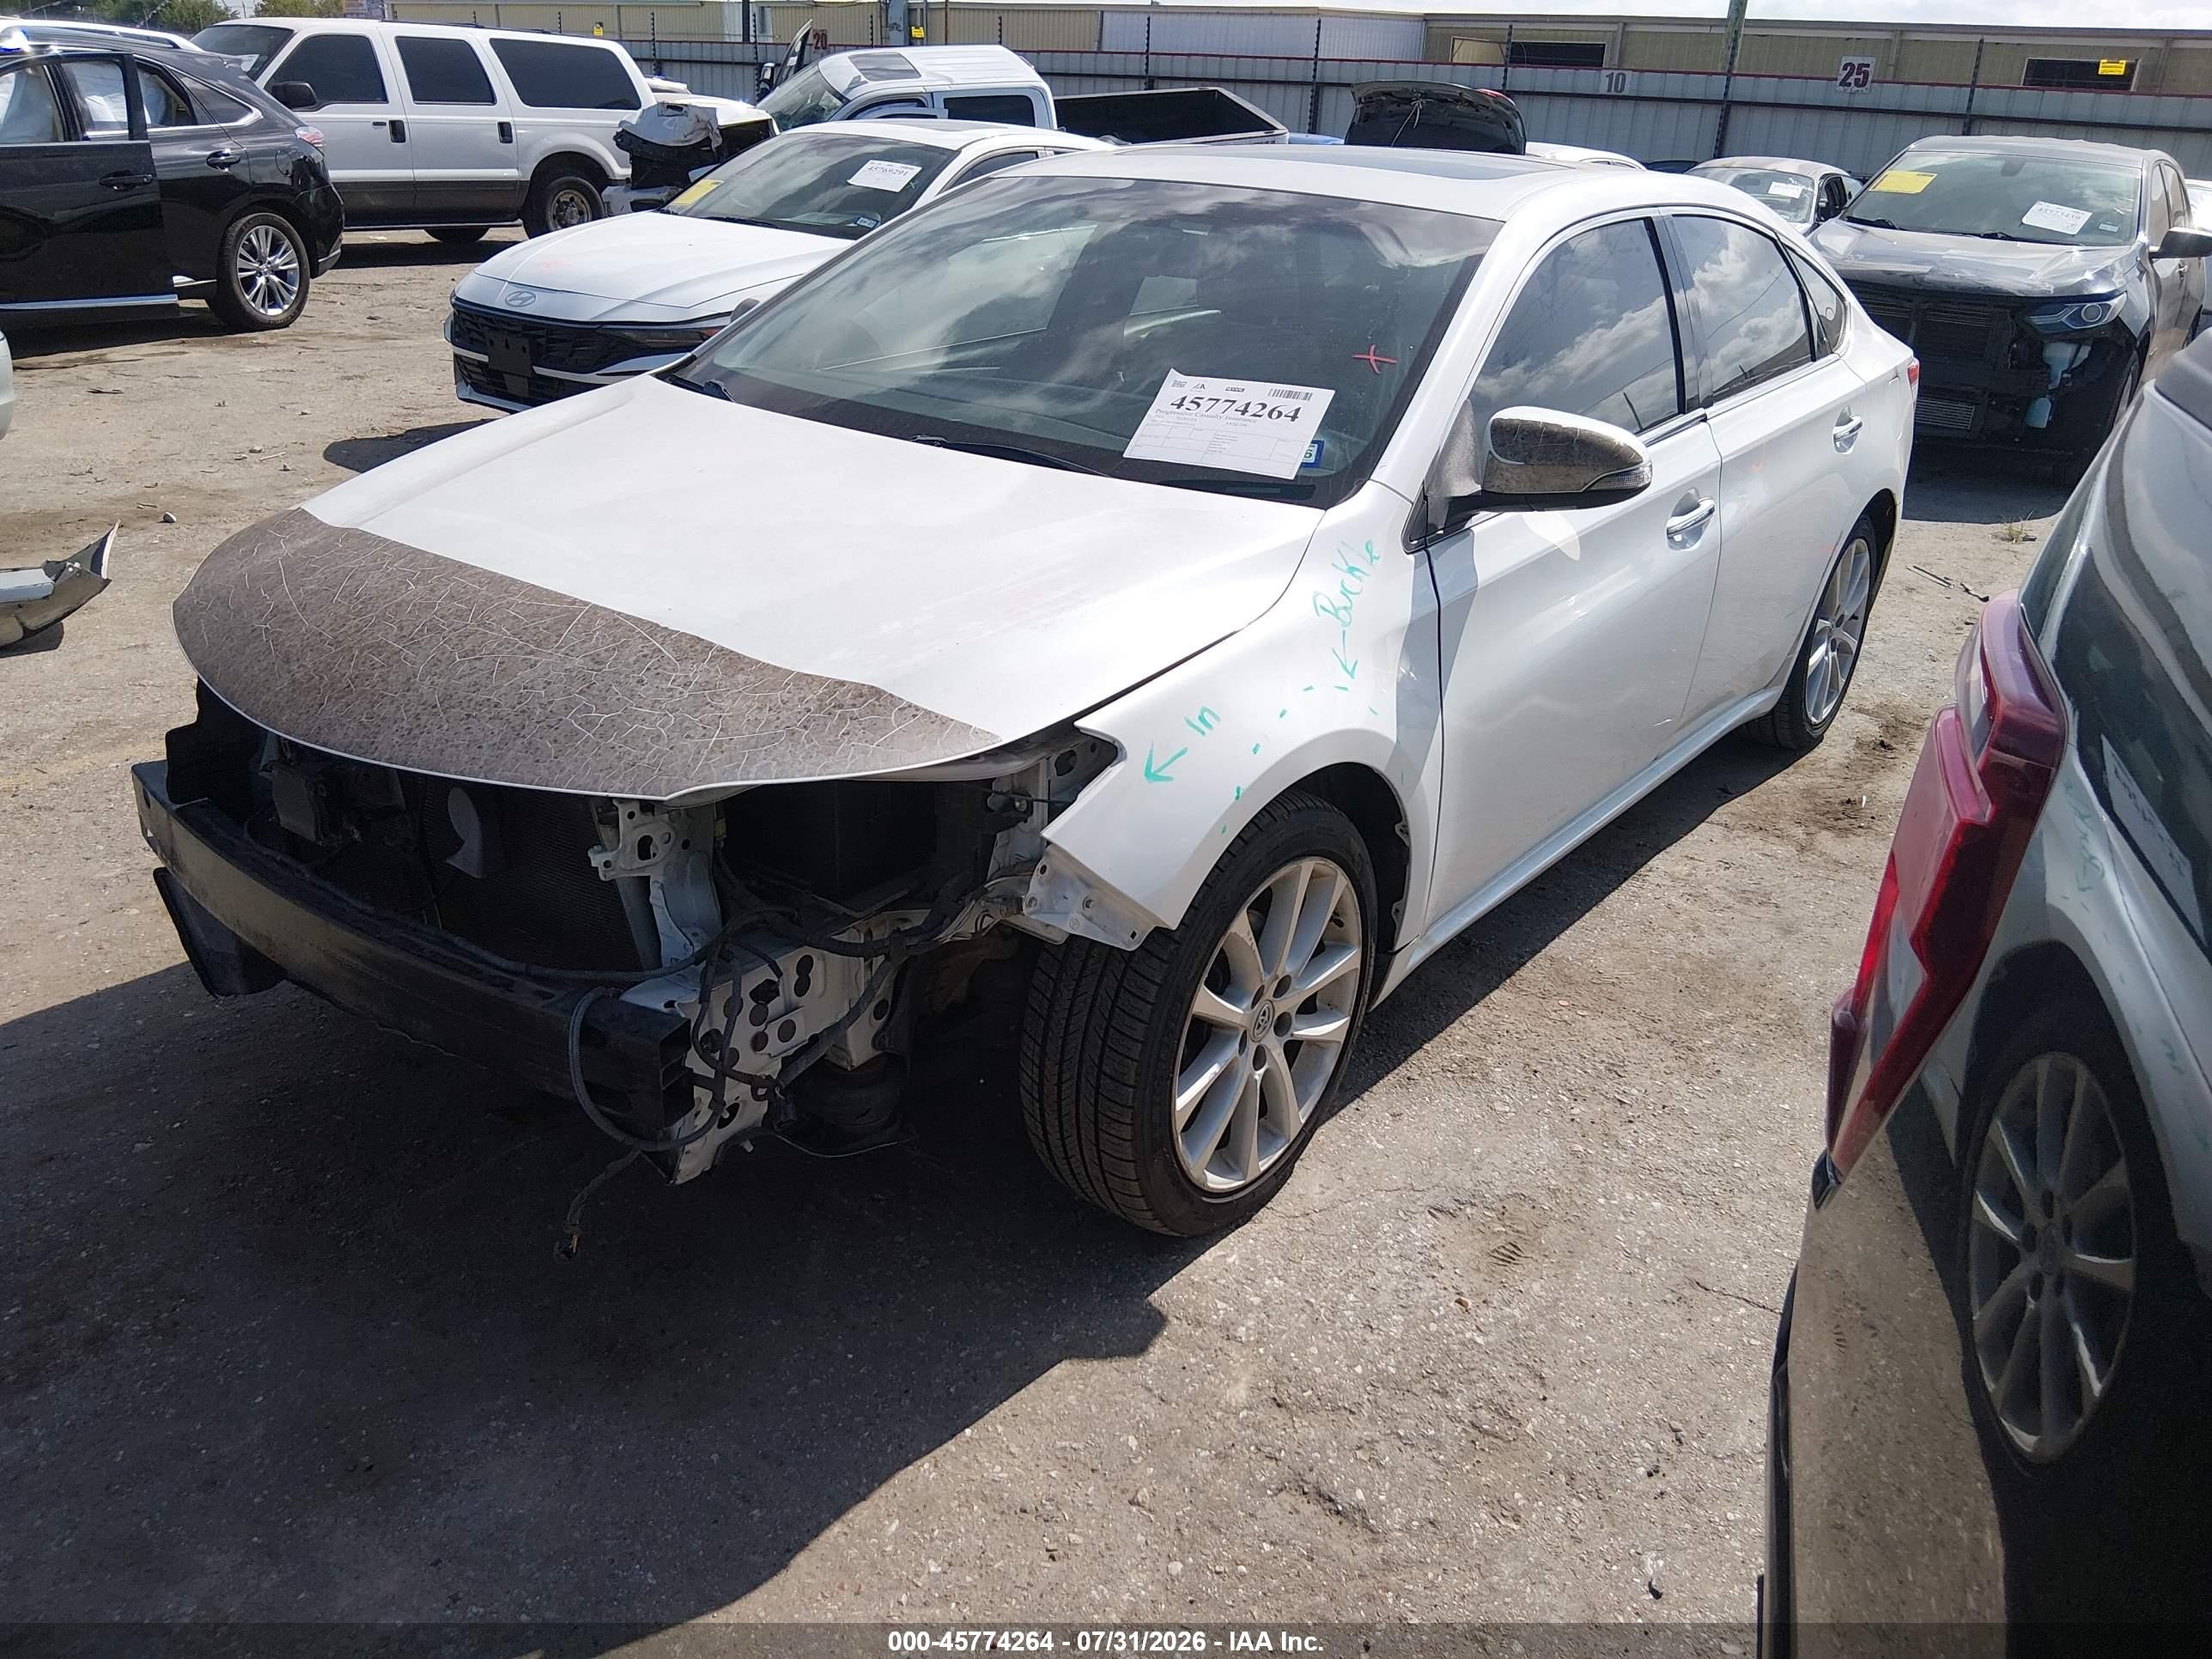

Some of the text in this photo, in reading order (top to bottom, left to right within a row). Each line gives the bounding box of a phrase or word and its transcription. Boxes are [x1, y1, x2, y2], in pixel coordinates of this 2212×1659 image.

[813, 33, 828, 50] 20
[1606, 72, 1626, 93] 10
[1838, 62, 1870, 88] 25
[1170, 395, 1302, 422] 45774264
